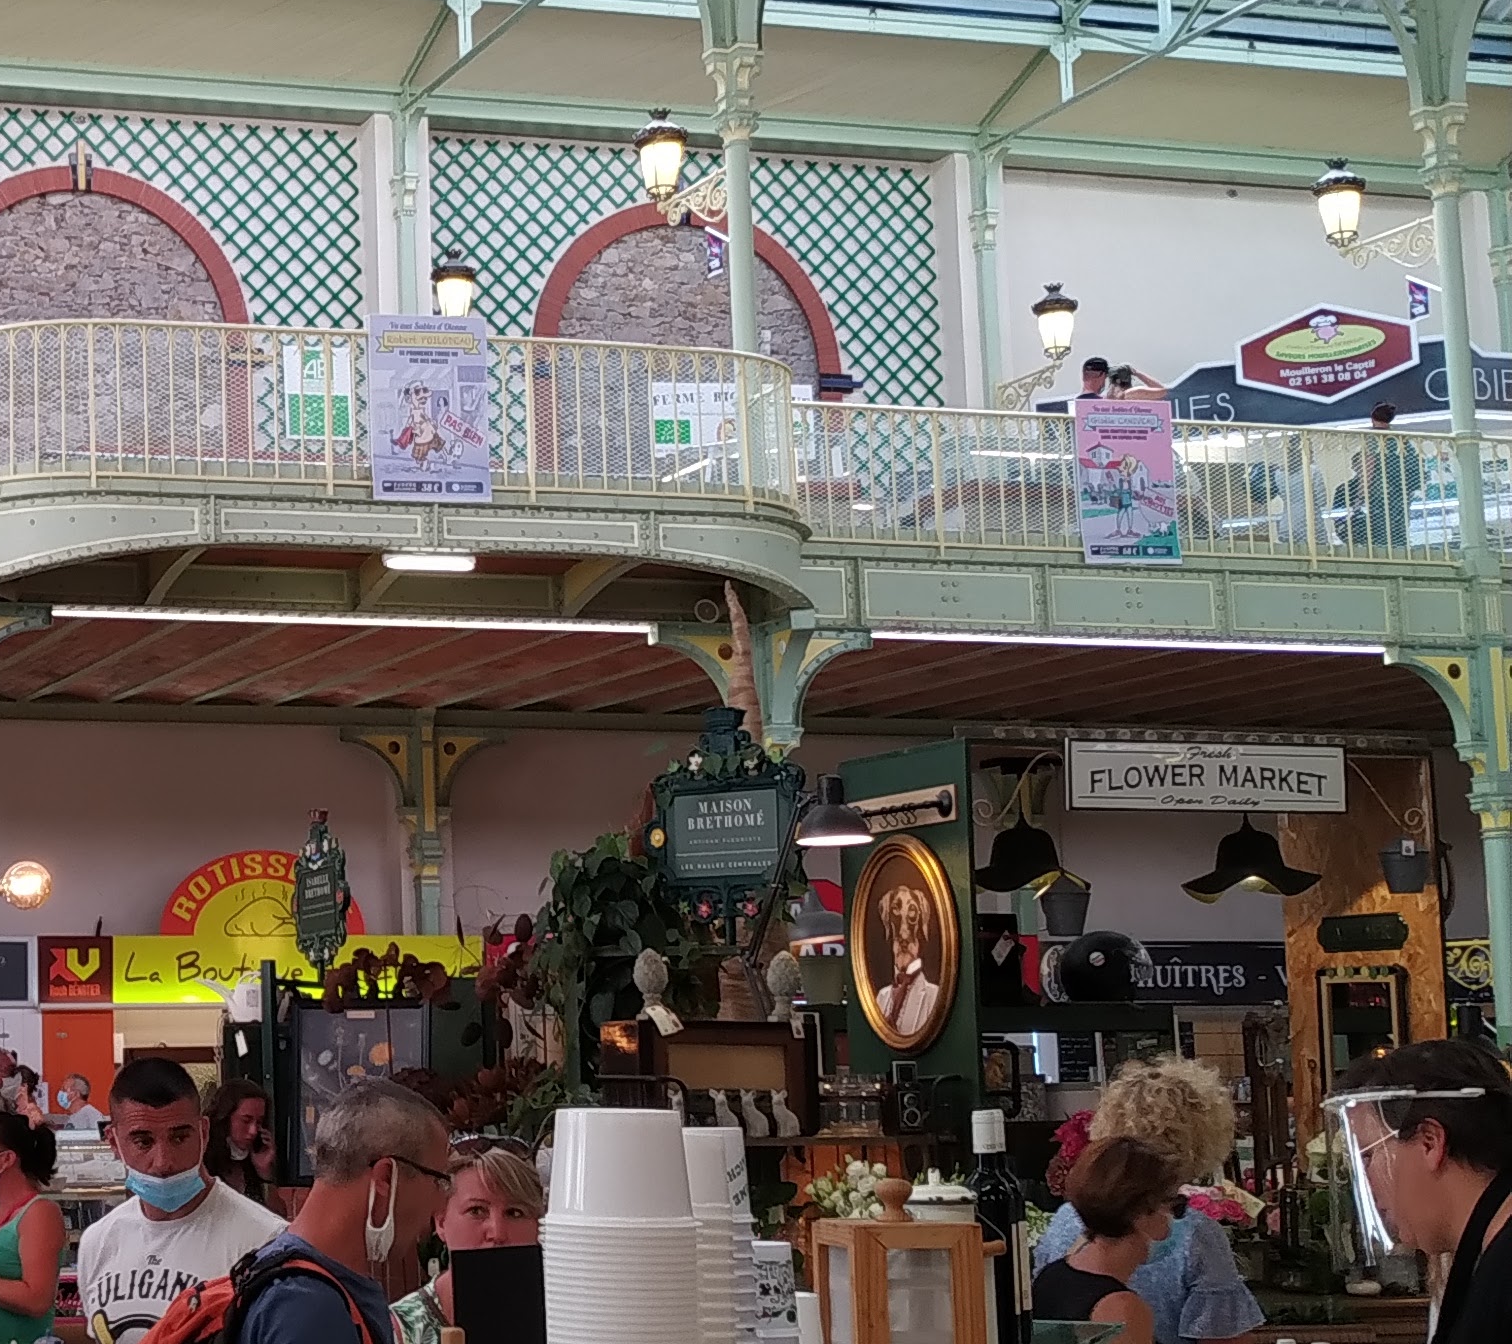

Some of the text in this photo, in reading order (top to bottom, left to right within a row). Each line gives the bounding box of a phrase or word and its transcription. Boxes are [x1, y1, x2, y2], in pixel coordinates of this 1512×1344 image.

[1279, 358, 1376, 378] Mouilleron le Captif
[1289, 377, 1303, 387] 02
[1305, 375, 1318, 386] 51
[444, 414, 484, 447] PAS BIEN
[1185, 745, 1235, 760] Fresh
[1089, 763, 1328, 797] FLOWER MARKET
[698, 798, 752, 815] MAISON
[1159, 794, 1262, 807] Open Daily
[688, 809, 765, 830] BRETHOMÉ
[680, 860, 772, 871] LES HALLES CENTRALES
[171, 853, 296, 923] ROTISS
[124, 950, 303, 984] La Boutue
[146, 1254, 162, 1266] The
